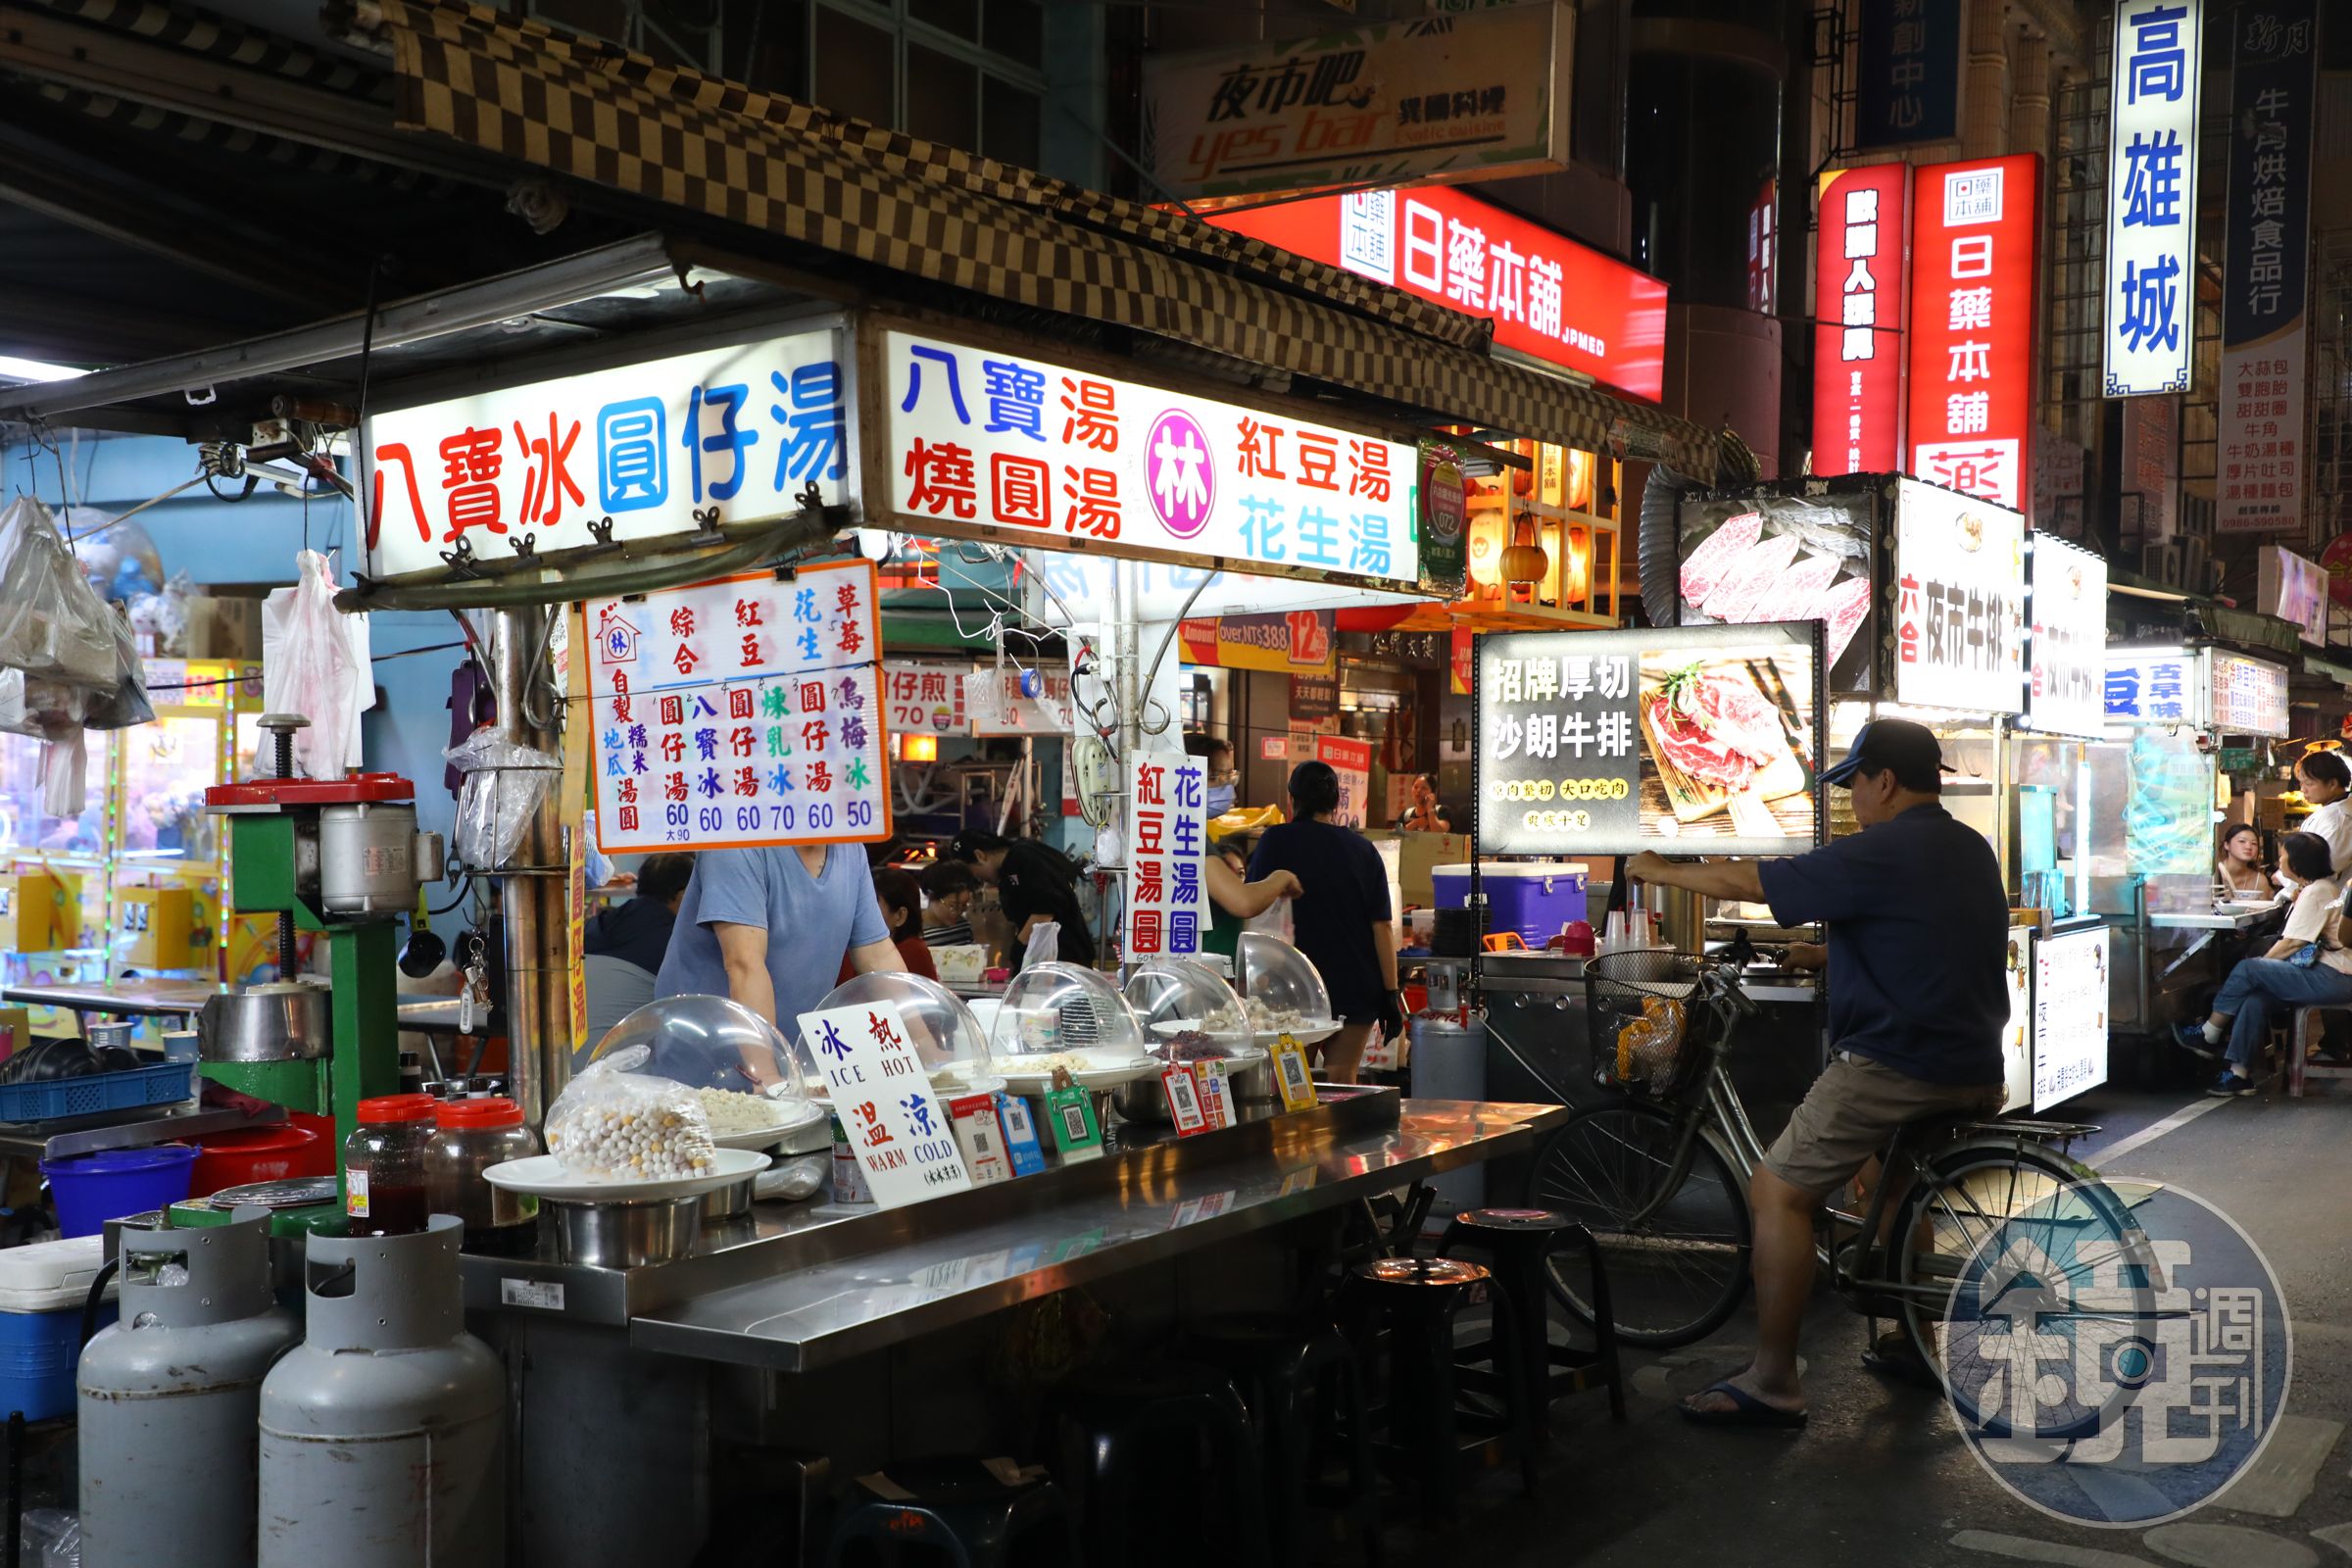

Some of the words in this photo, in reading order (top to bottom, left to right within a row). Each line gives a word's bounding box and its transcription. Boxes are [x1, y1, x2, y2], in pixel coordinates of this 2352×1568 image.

[1206, 50, 1370, 122] 夜市吧
[1181, 123, 1287, 182] yes
[1294, 109, 1391, 154] bar
[2119, 5, 2187, 354] 高雄城
[2248, 88, 2289, 316] 牛角烘焙食品行
[1404, 199, 1562, 340] 日藥本舖
[1562, 327, 1604, 359] JPMED
[1947, 234, 1992, 434] 日藥本舖
[2237, 380, 2287, 398] 雙胞胎
[2238, 360, 2288, 377] 大蒜包
[901, 344, 1120, 454] 八寶湯
[2236, 401, 2287, 418] 甜甜圈
[2228, 441, 2294, 460] 牛奶湯種
[2245, 422, 2278, 437] 牛角
[1153, 425, 1209, 520] 林
[1236, 416, 1392, 503] 紅豆湯
[2227, 462, 2294, 479] 厚片吐司
[904, 437, 1123, 540] 燒圓湯
[1237, 494, 1392, 575] 花生湯
[1439, 512, 1454, 531] 072
[670, 606, 699, 675] 綜合
[735, 599, 764, 666] 紅豆
[794, 588, 822, 661] 花生
[836, 584, 864, 654] 草莓
[1900, 572, 1920, 663] 六合
[1926, 578, 2003, 673] 夜市牛排
[612, 668, 633, 723] 自製
[884, 671, 947, 702] 仔煎
[1489, 655, 1630, 704] 招牌厚切
[801, 681, 832, 792] 圓仔湯
[839, 676, 871, 792] 烏梅冰
[894, 707, 924, 724] 70
[1490, 711, 1633, 760] 沙朗牛排
[604, 729, 627, 777] 地瓜
[628, 724, 650, 775] 糯米
[661, 696, 689, 802] 圓仔湯
[692, 695, 724, 800] 八寶冰
[730, 688, 759, 797] 圓仔湯
[617, 778, 639, 831] 湯圓
[848, 800, 871, 826] 50
[1562, 782, 1624, 796] 大口吃肉
[666, 804, 688, 825] 60
[700, 807, 722, 831] 60
[737, 806, 760, 830] 60
[770, 806, 794, 830] 70
[808, 804, 833, 827] 60
[1132, 761, 1166, 953] 紅豆湯圓
[1169, 765, 1202, 953] 花生湯圓
[813, 1018, 854, 1061] 冰
[868, 1010, 903, 1054] 熱
[830, 1065, 866, 1088] ICE
[881, 1054, 916, 1078] HOT
[852, 1101, 895, 1149] 溫
[899, 1093, 939, 1138] 涼
[865, 1148, 908, 1173] WARM
[913, 1138, 955, 1164] COLD
